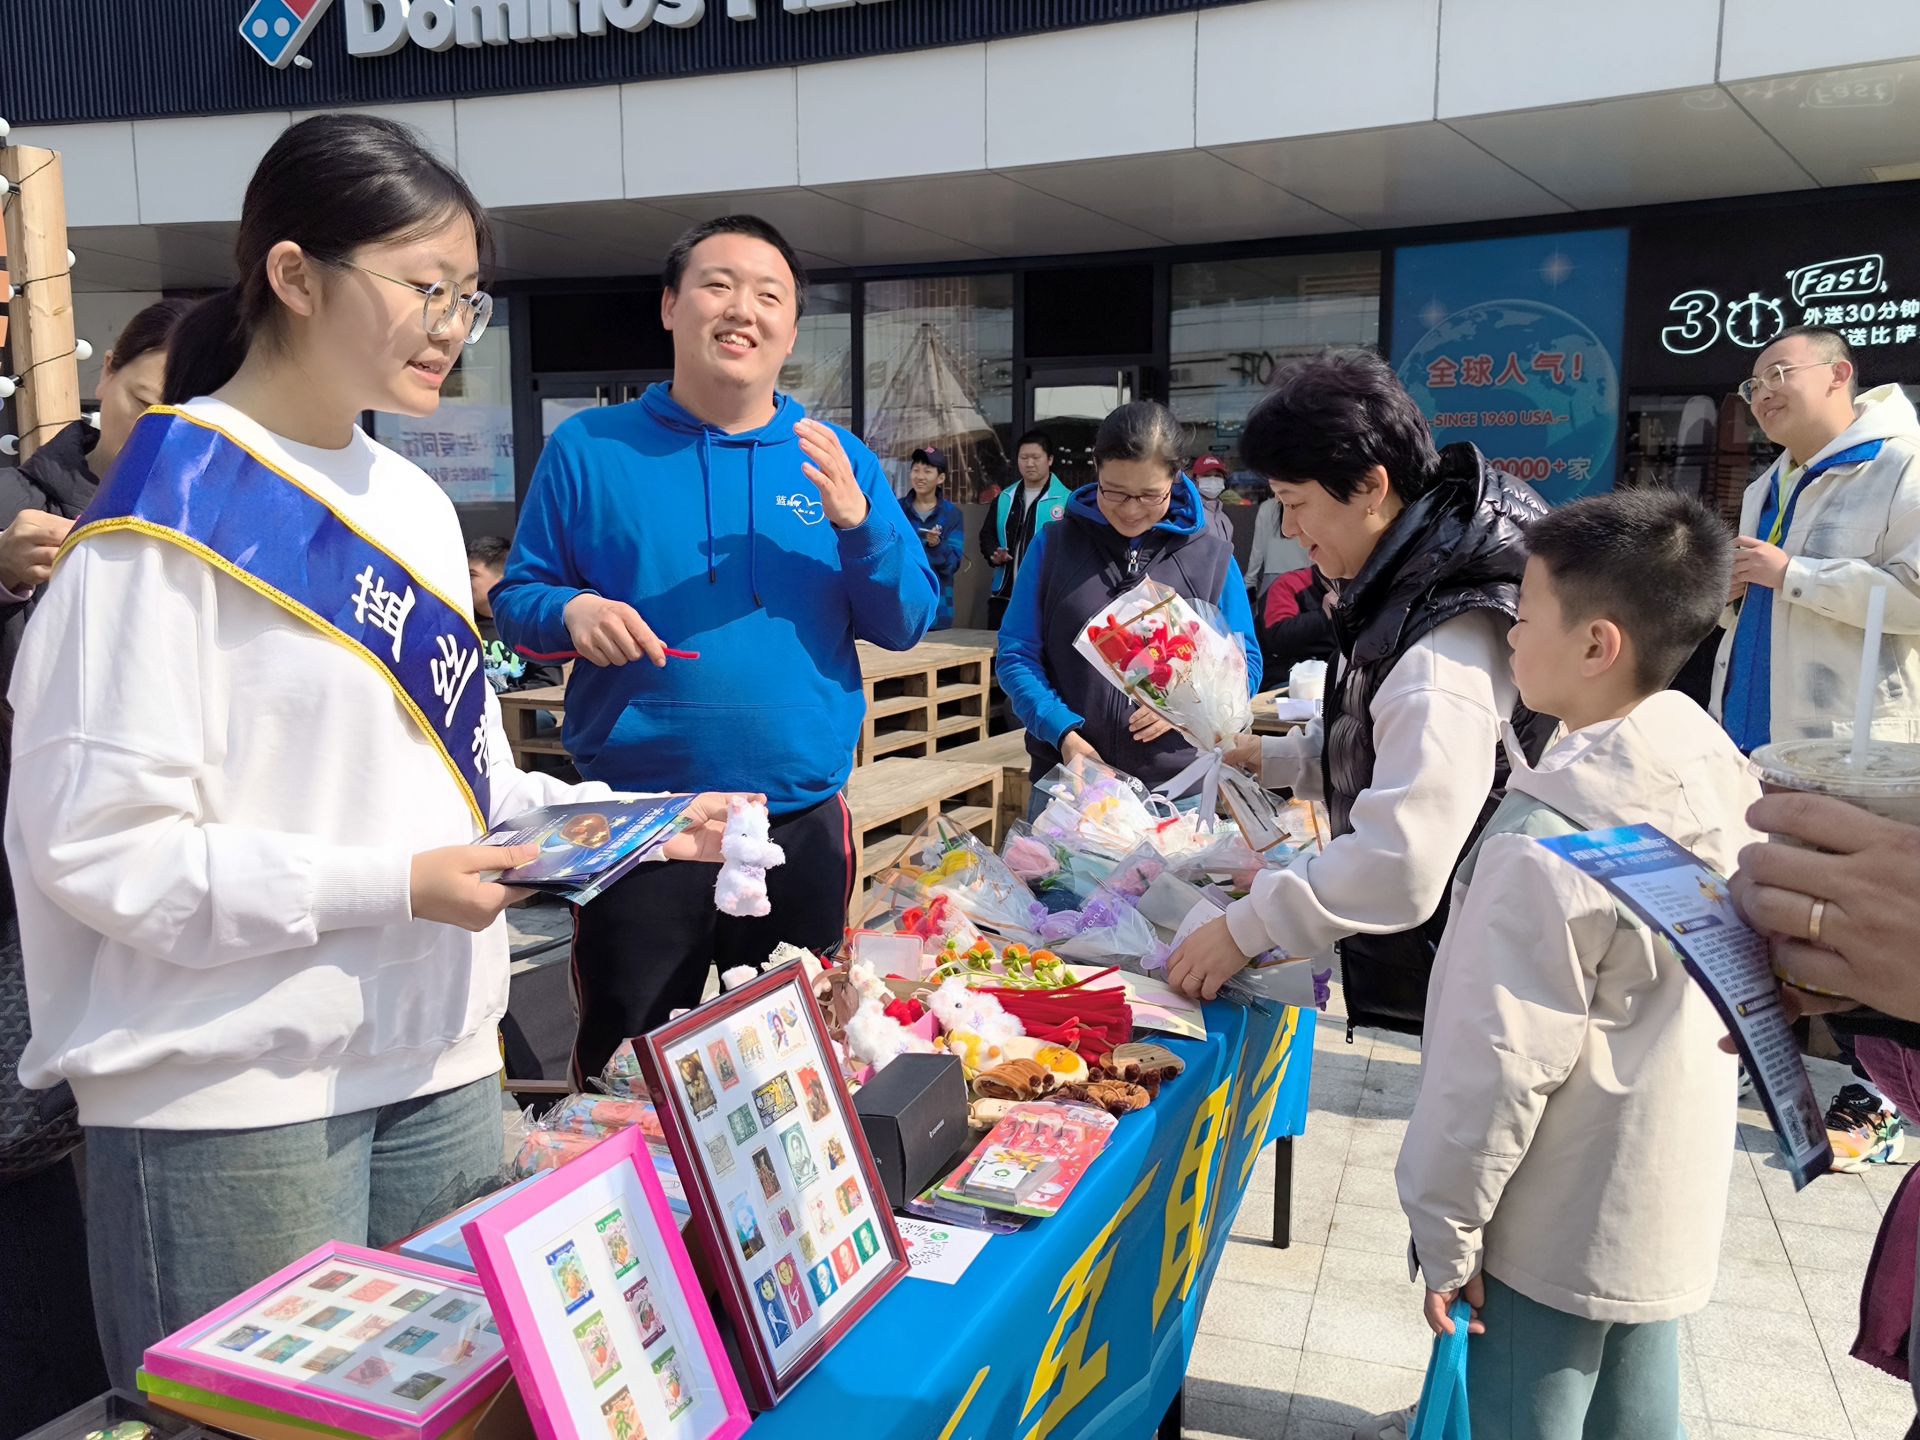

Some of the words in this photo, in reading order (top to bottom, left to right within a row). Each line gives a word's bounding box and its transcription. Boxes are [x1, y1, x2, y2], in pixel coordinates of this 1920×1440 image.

[1799, 261, 1876, 295] Fast
[1803, 299, 1920, 326] 外送30分钟
[1840, 324, 1917, 346] 送比萨
[1427, 352, 1583, 389] 全球人气！
[1482, 411, 1517, 427] 1960
